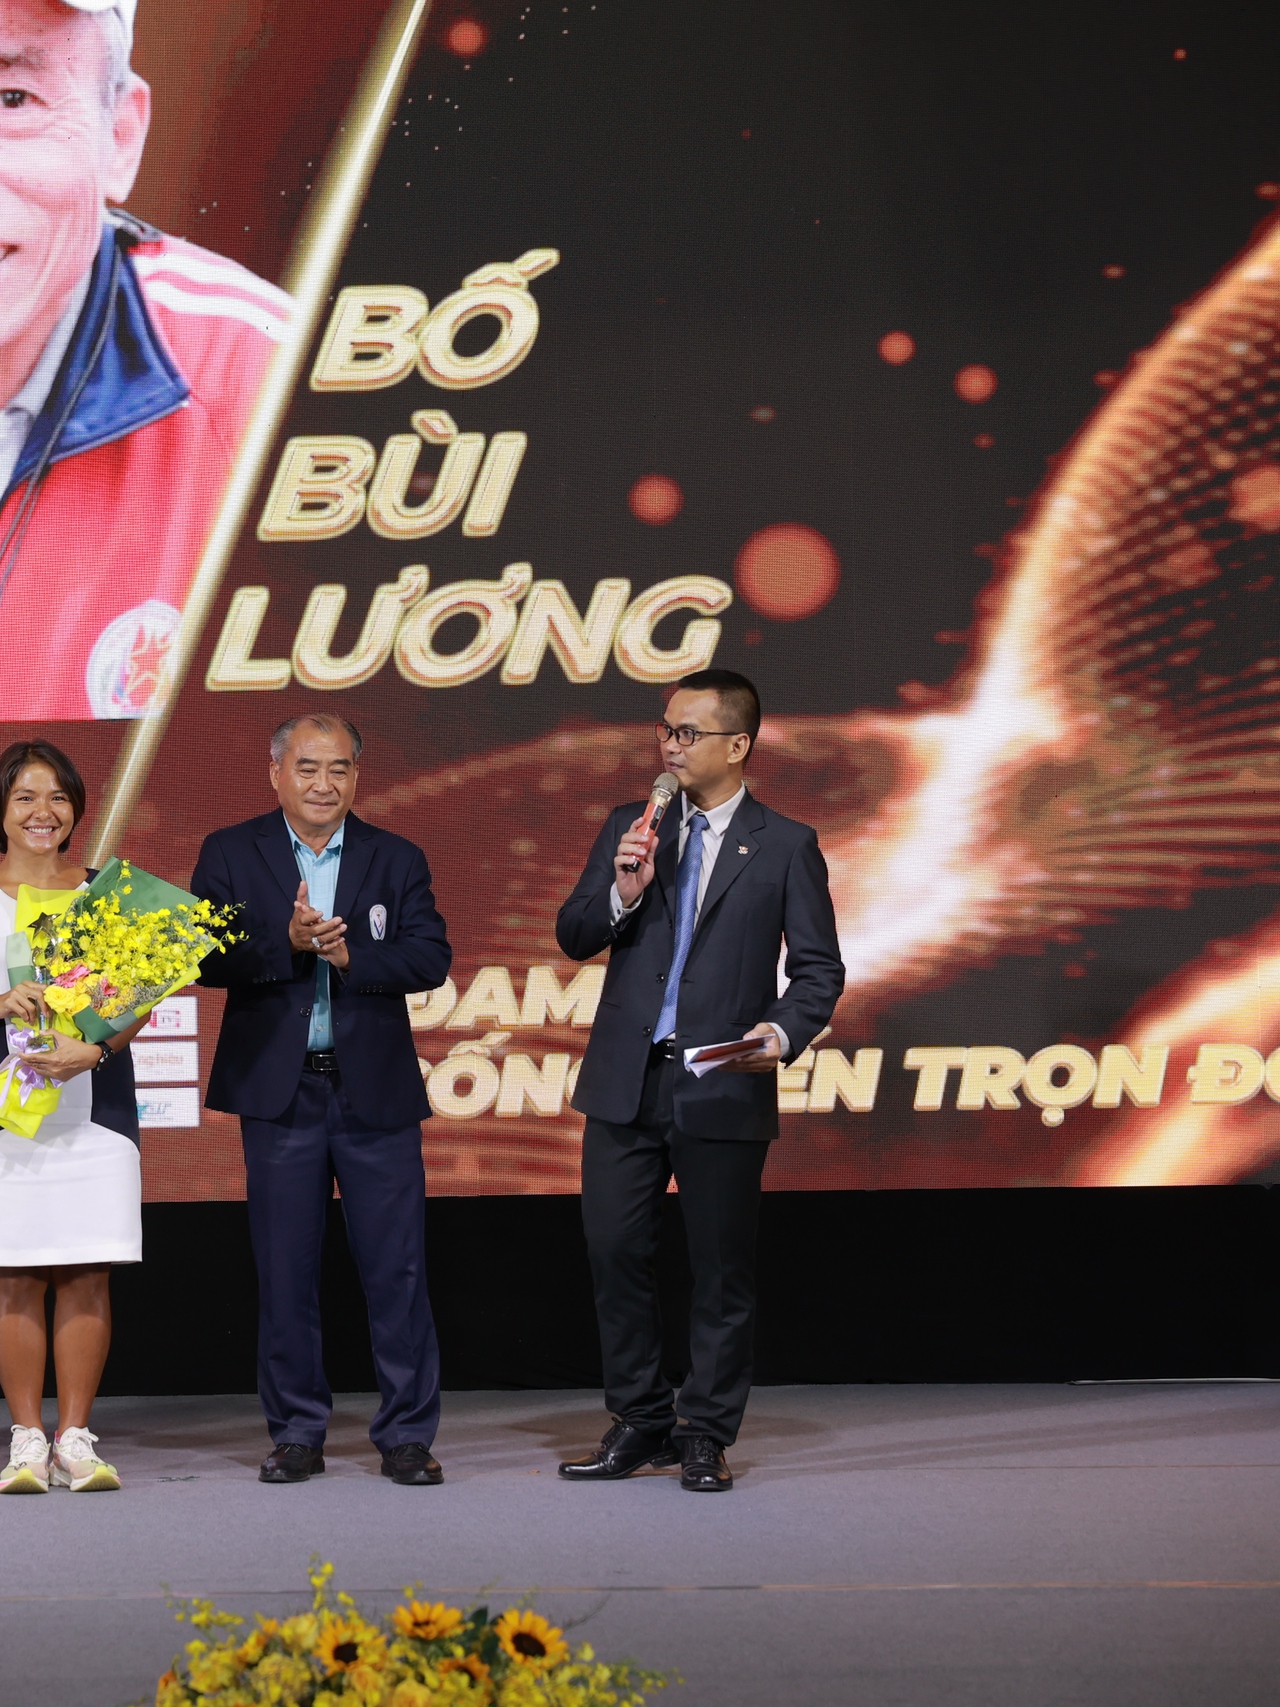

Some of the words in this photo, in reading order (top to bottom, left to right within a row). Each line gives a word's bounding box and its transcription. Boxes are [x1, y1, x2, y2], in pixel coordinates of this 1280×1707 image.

[310, 247, 560, 392] BỐ
[257, 409, 527, 541] BÙI
[205, 562, 732, 691] LƯƠNG
[418, 1032, 583, 1119] ỐN
[904, 1043, 1169, 1127] TRỌN
[1186, 1043, 1280, 1105] Đ
